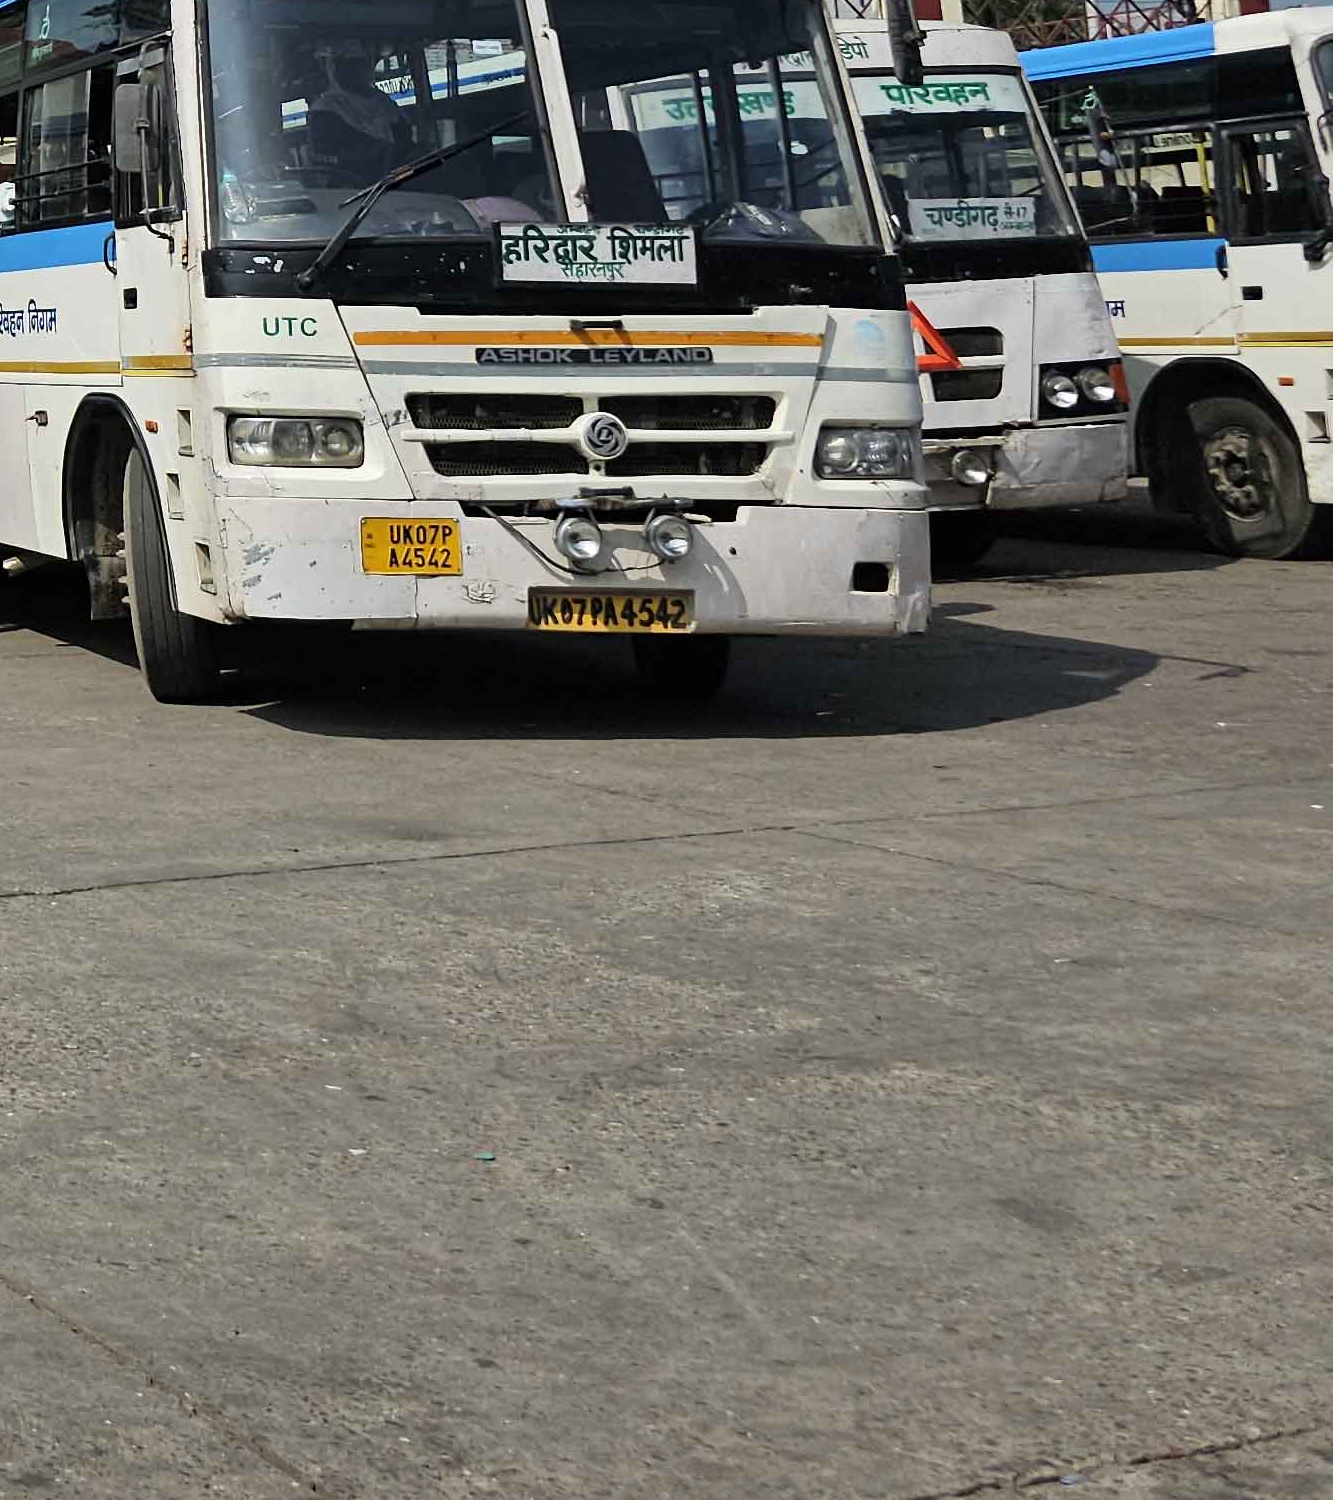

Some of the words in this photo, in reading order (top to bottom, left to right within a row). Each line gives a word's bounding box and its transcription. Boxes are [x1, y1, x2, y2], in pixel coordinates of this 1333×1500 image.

[607, 225, 690, 265] शिमला
[28, 298, 57, 334] निगम
[261, 316, 318, 338] UTC
[479, 347, 574, 364] ASHOK
[588, 347, 713, 364] LEYLAND
[389, 524, 454, 546] UK07P
[388, 547, 453, 569] A4542
[529, 597, 688, 629] UK07PA4542
